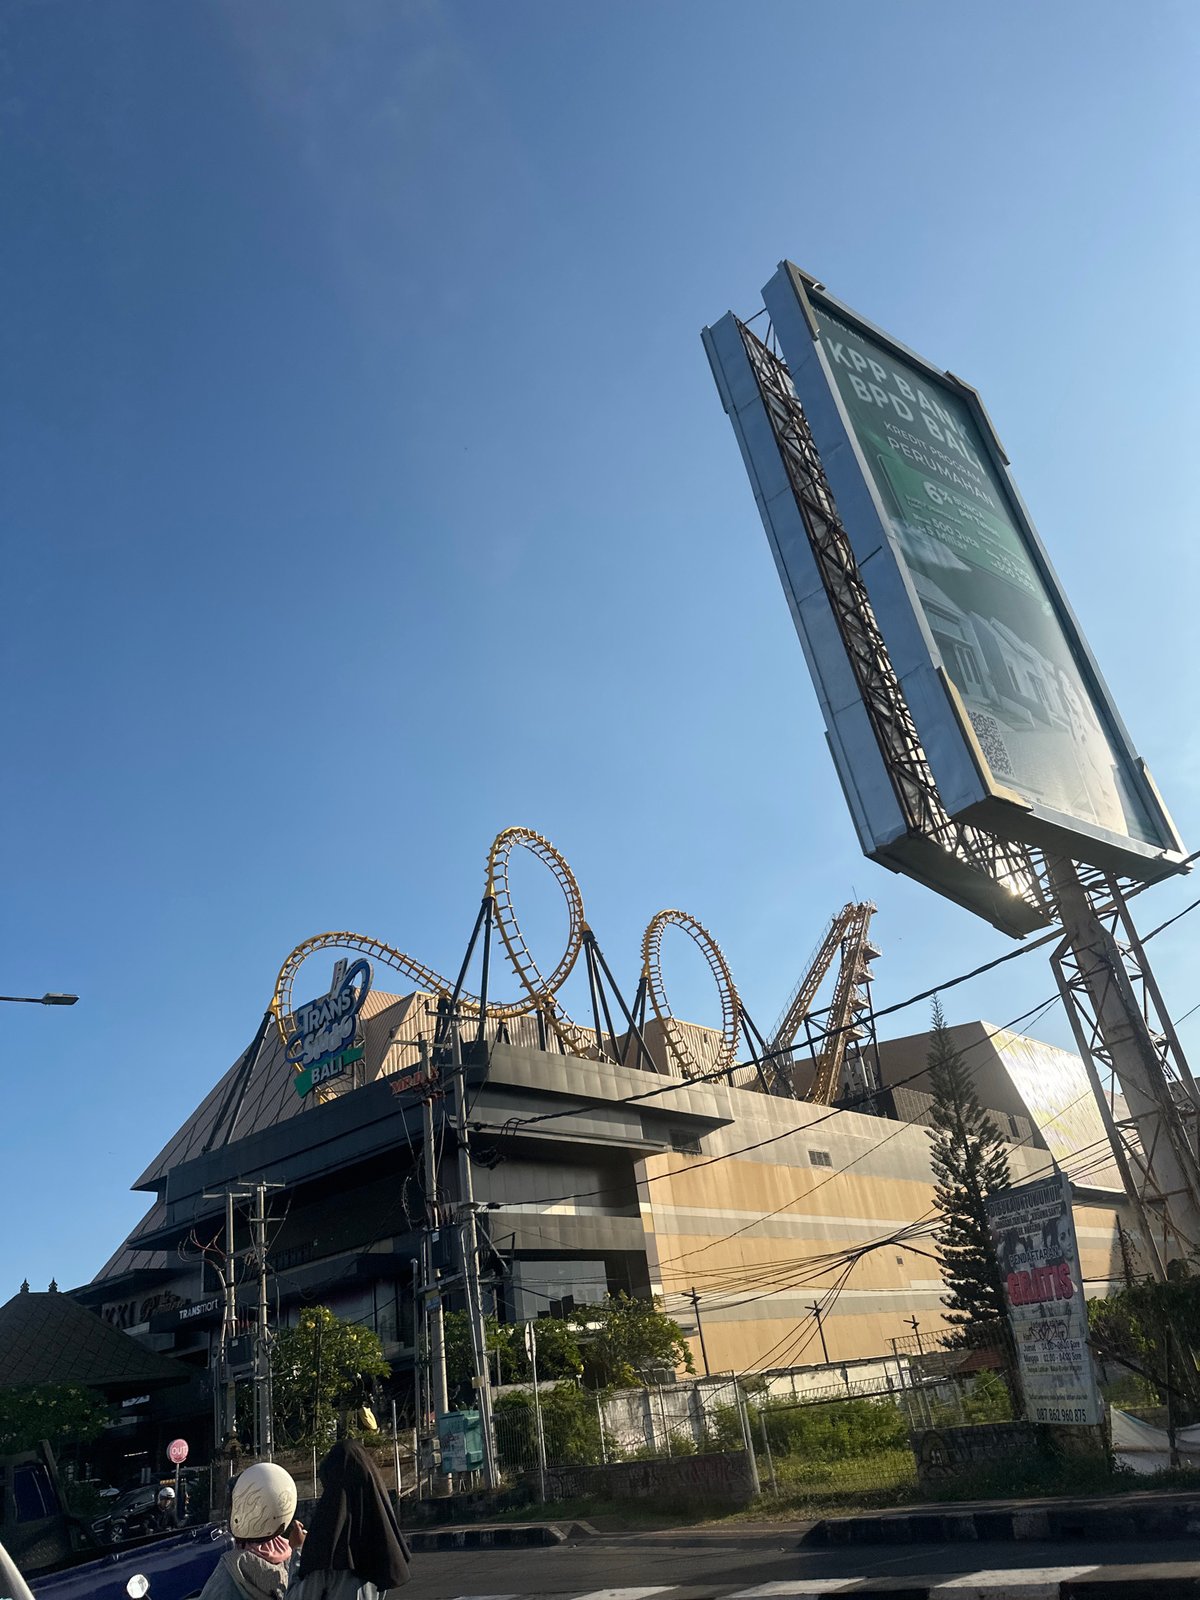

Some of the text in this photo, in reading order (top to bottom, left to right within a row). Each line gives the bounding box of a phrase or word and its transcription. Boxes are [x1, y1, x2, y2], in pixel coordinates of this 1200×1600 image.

[827, 338, 976, 448] KPP BANK
[848, 373, 986, 475] BPD BALI
[884, 422, 982, 484] KREDIT PROGRAM
[887, 437, 995, 508] PERUMAHAN
[923, 481, 953, 505] 6%
[299, 988, 351, 1034] TRANS
[311, 1057, 343, 1085] BALI
[1009, 1246, 1059, 1265] PENDAFTARAN
[1007, 1263, 1073, 1306] GRATIS
[171, 1446, 187, 1455] OUT
